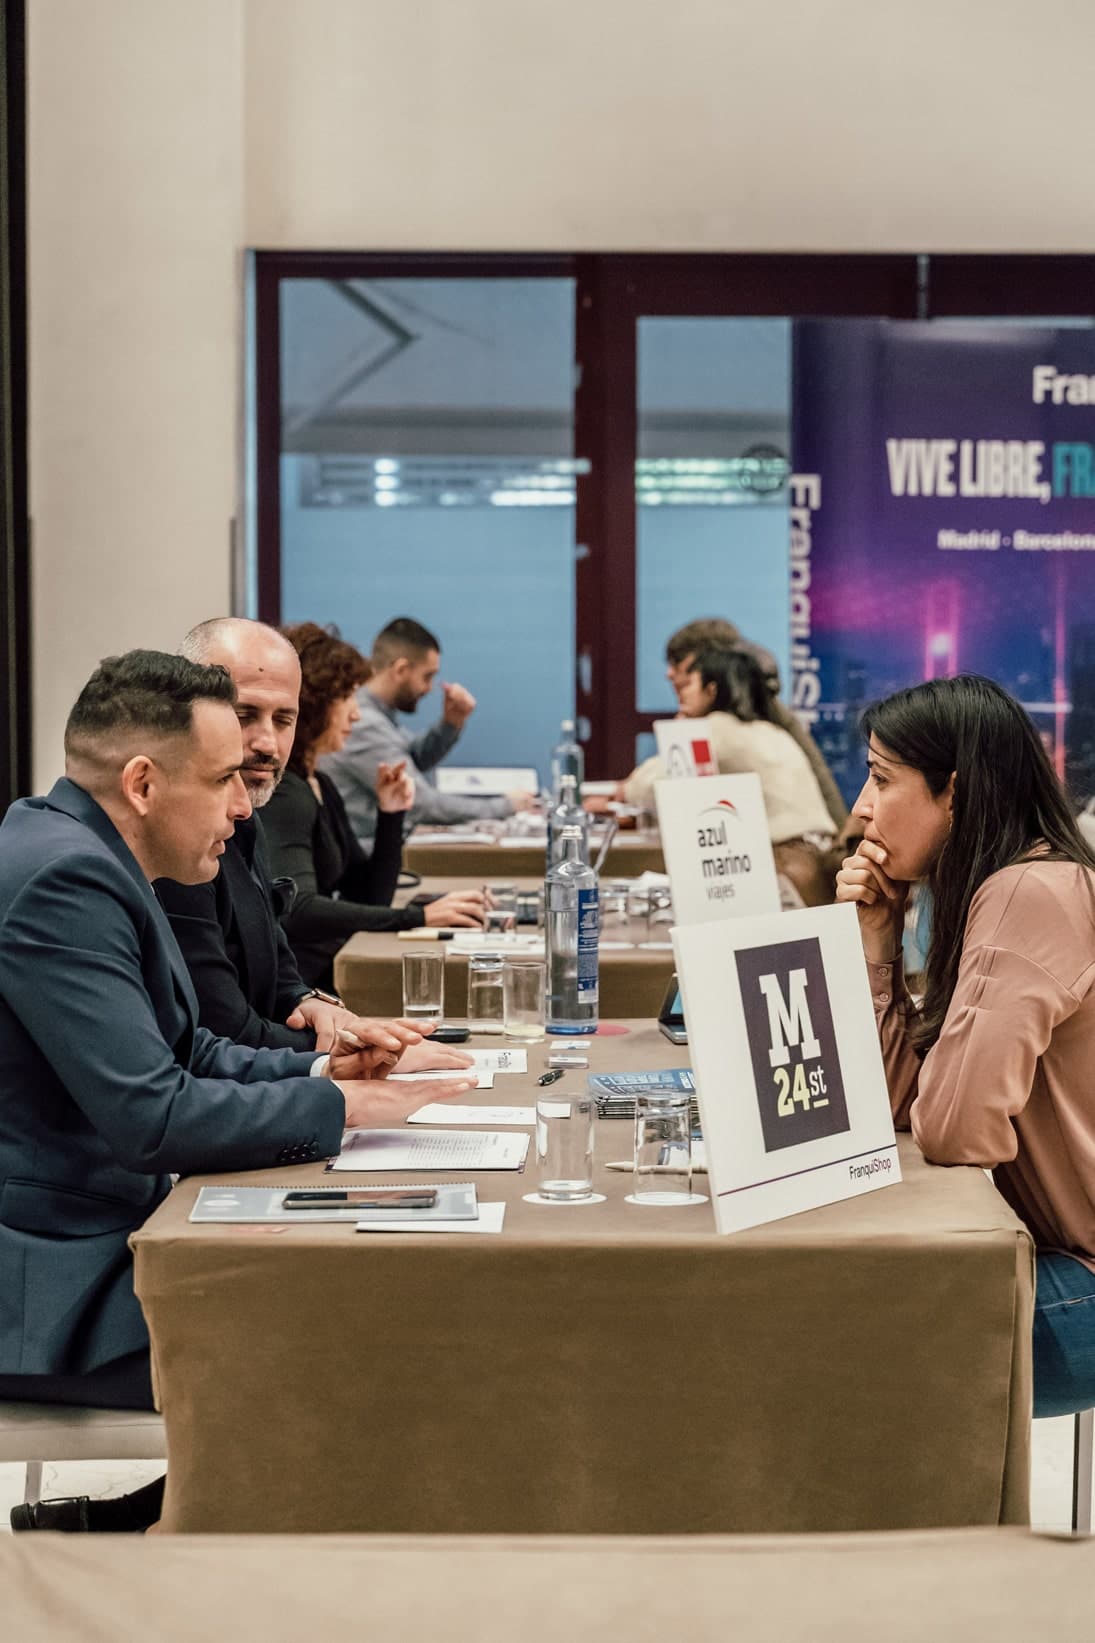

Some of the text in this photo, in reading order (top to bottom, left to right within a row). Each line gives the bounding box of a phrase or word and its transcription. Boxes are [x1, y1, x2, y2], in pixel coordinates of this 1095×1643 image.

[886, 438, 957, 497] VIVE
[959, 438, 1051, 505] LIBRE,
[937, 528, 1001, 551] Madrid
[697, 821, 728, 848] azul
[701, 849, 752, 879] marino
[706, 882, 736, 903] viajes
[758, 967, 822, 1068] M
[849, 1157, 892, 1180] FranquiShop
